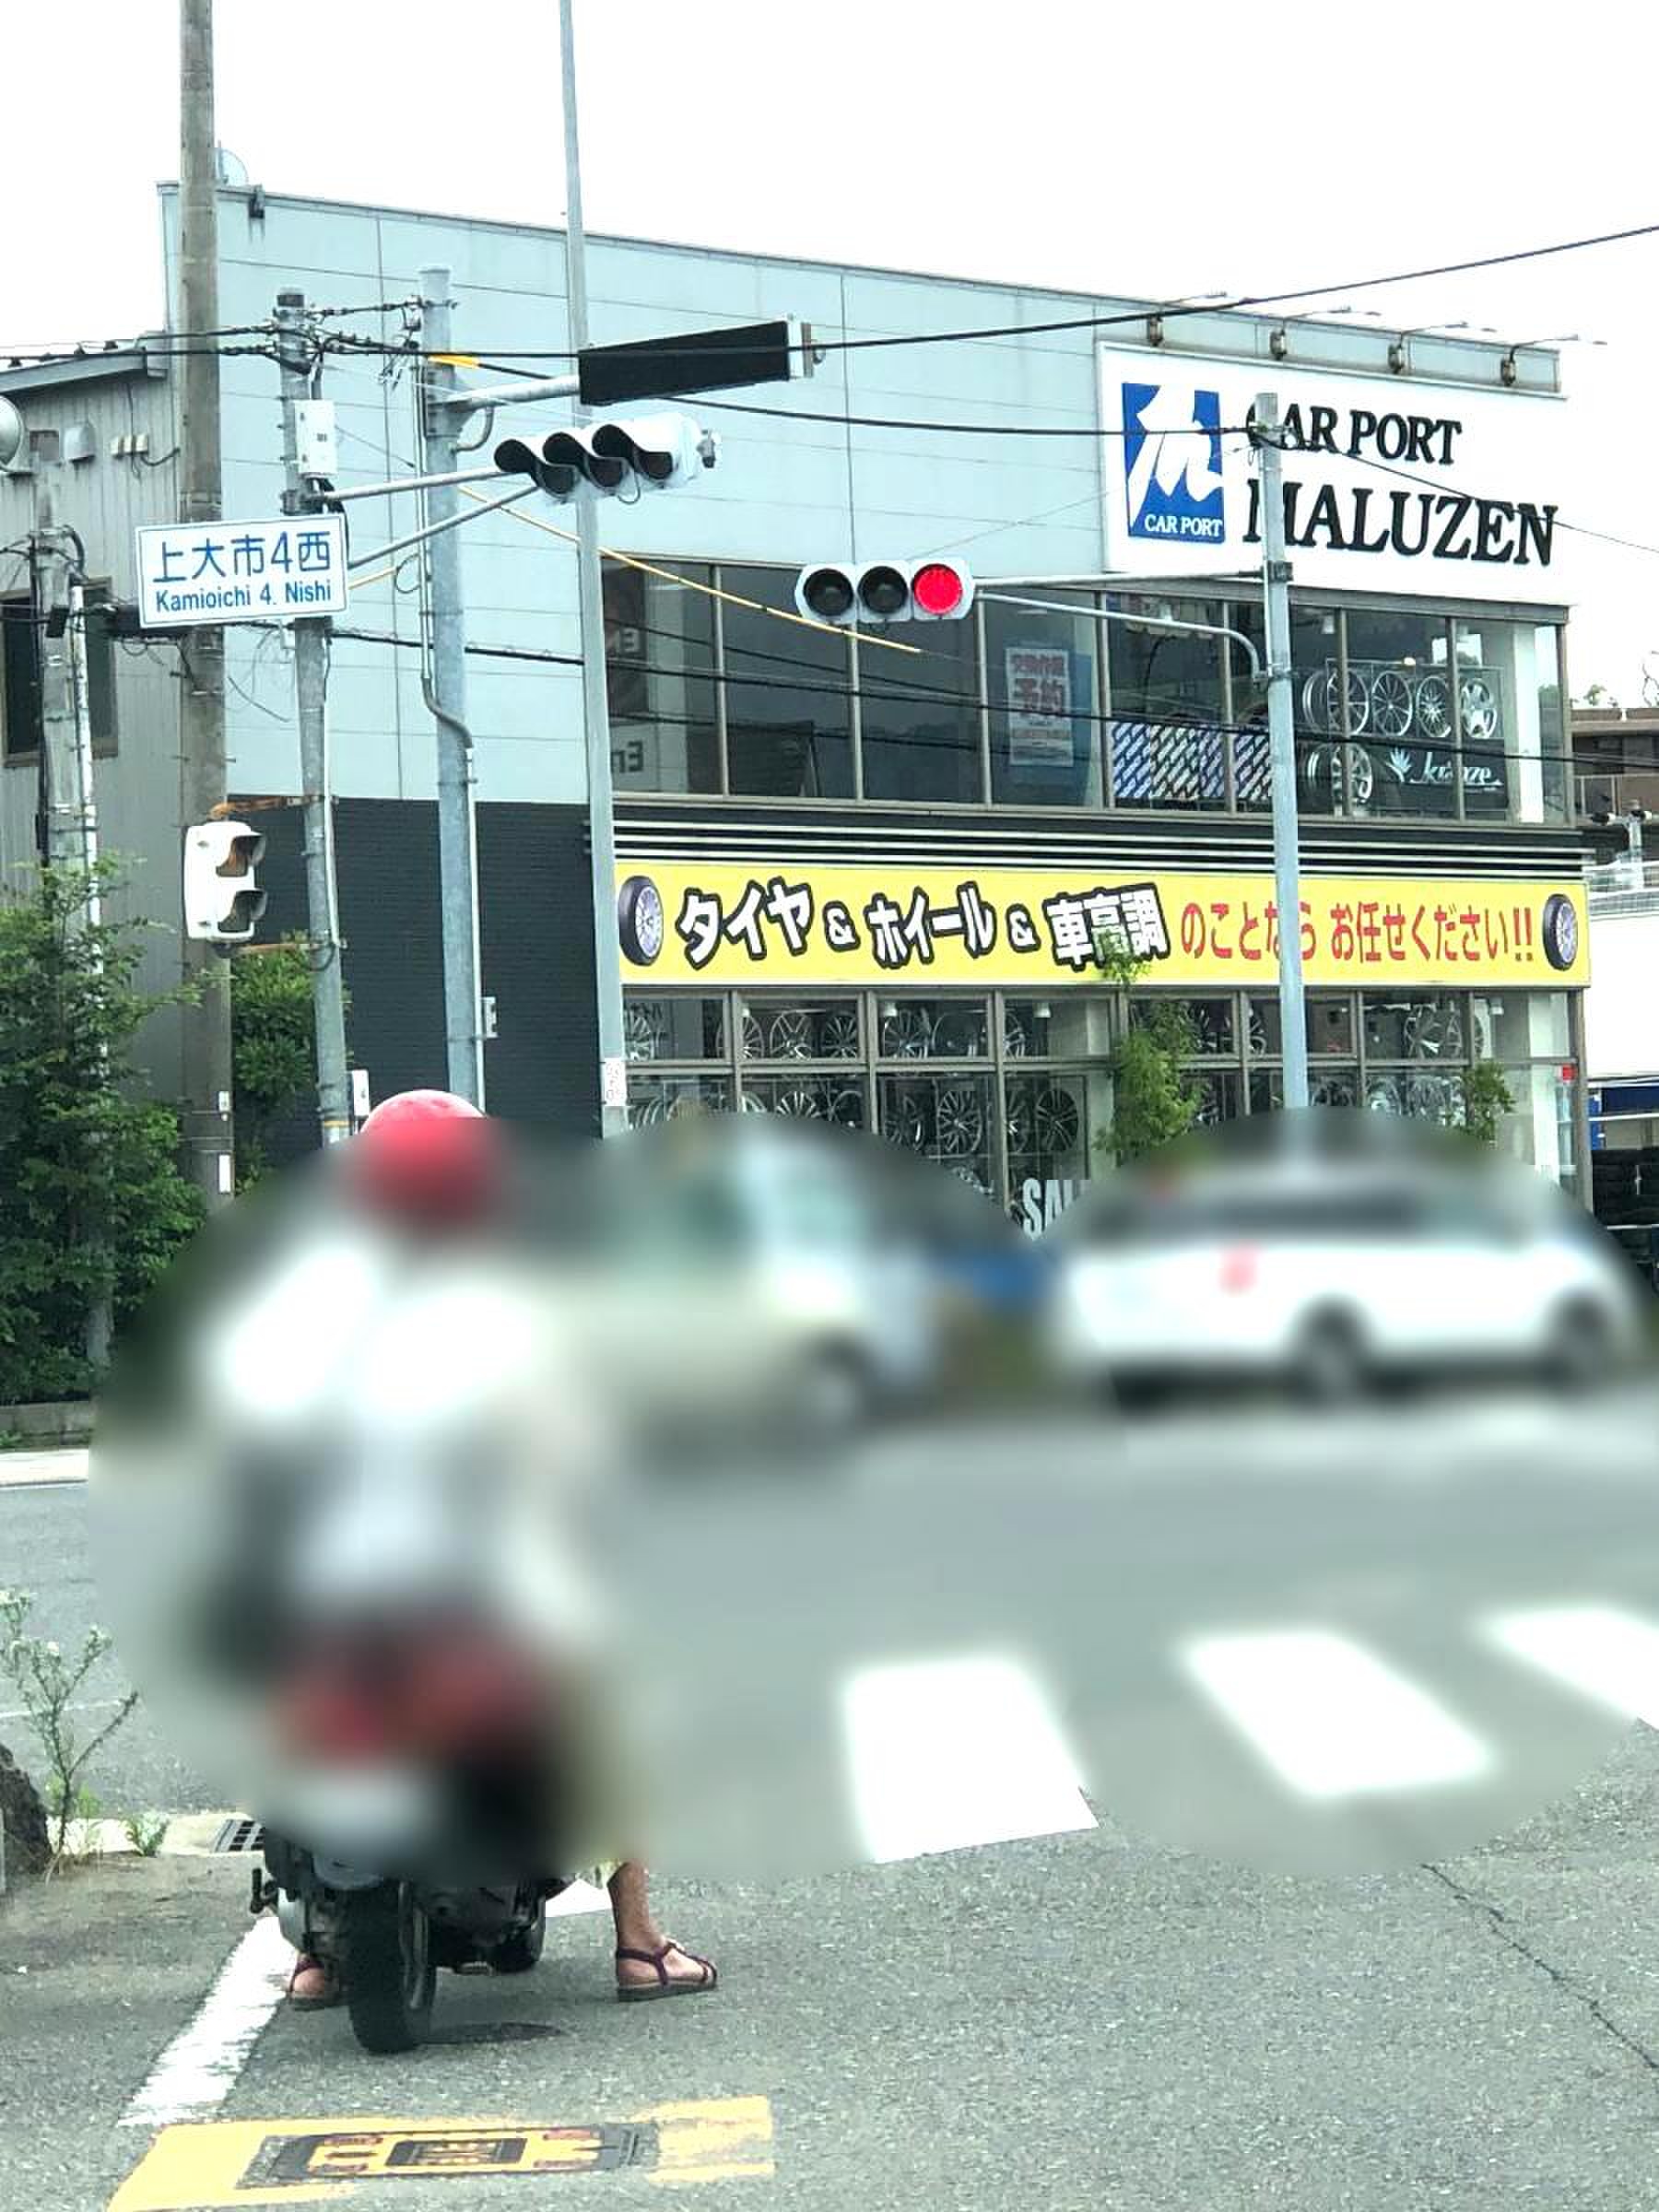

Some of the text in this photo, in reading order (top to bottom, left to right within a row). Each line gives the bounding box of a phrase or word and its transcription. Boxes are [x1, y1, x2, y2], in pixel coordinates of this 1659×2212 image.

[1347, 409, 1463, 465] PORT
[1144, 513, 1223, 536] CAR PORT
[153, 531, 331, 582] 上大市4西
[156, 584, 252, 612] Kamioichi
[285, 579, 332, 603] Nishi
[1022, 1177, 1089, 1241] SA
